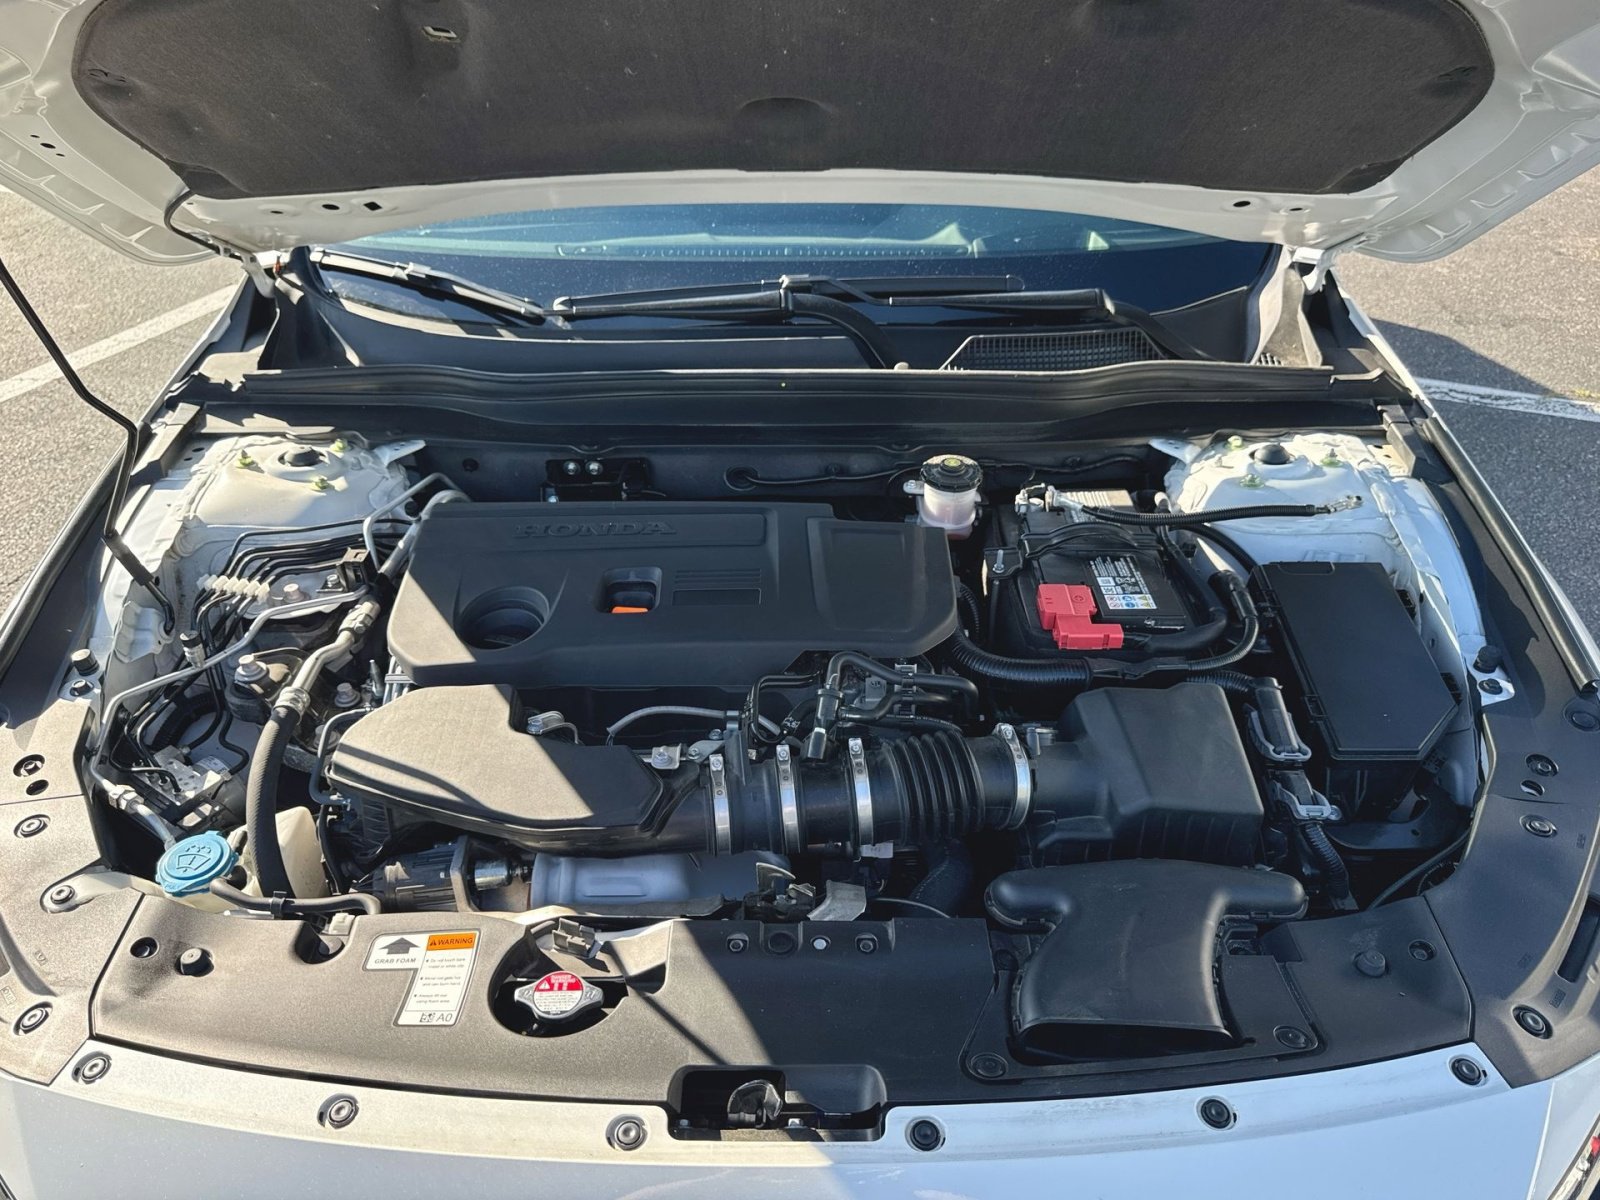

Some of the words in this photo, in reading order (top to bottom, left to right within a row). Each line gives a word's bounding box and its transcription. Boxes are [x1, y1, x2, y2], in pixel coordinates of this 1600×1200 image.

[512, 521, 677, 538] HONDA
[438, 937, 473, 946] WARNING
[436, 1013, 453, 1022] A0
